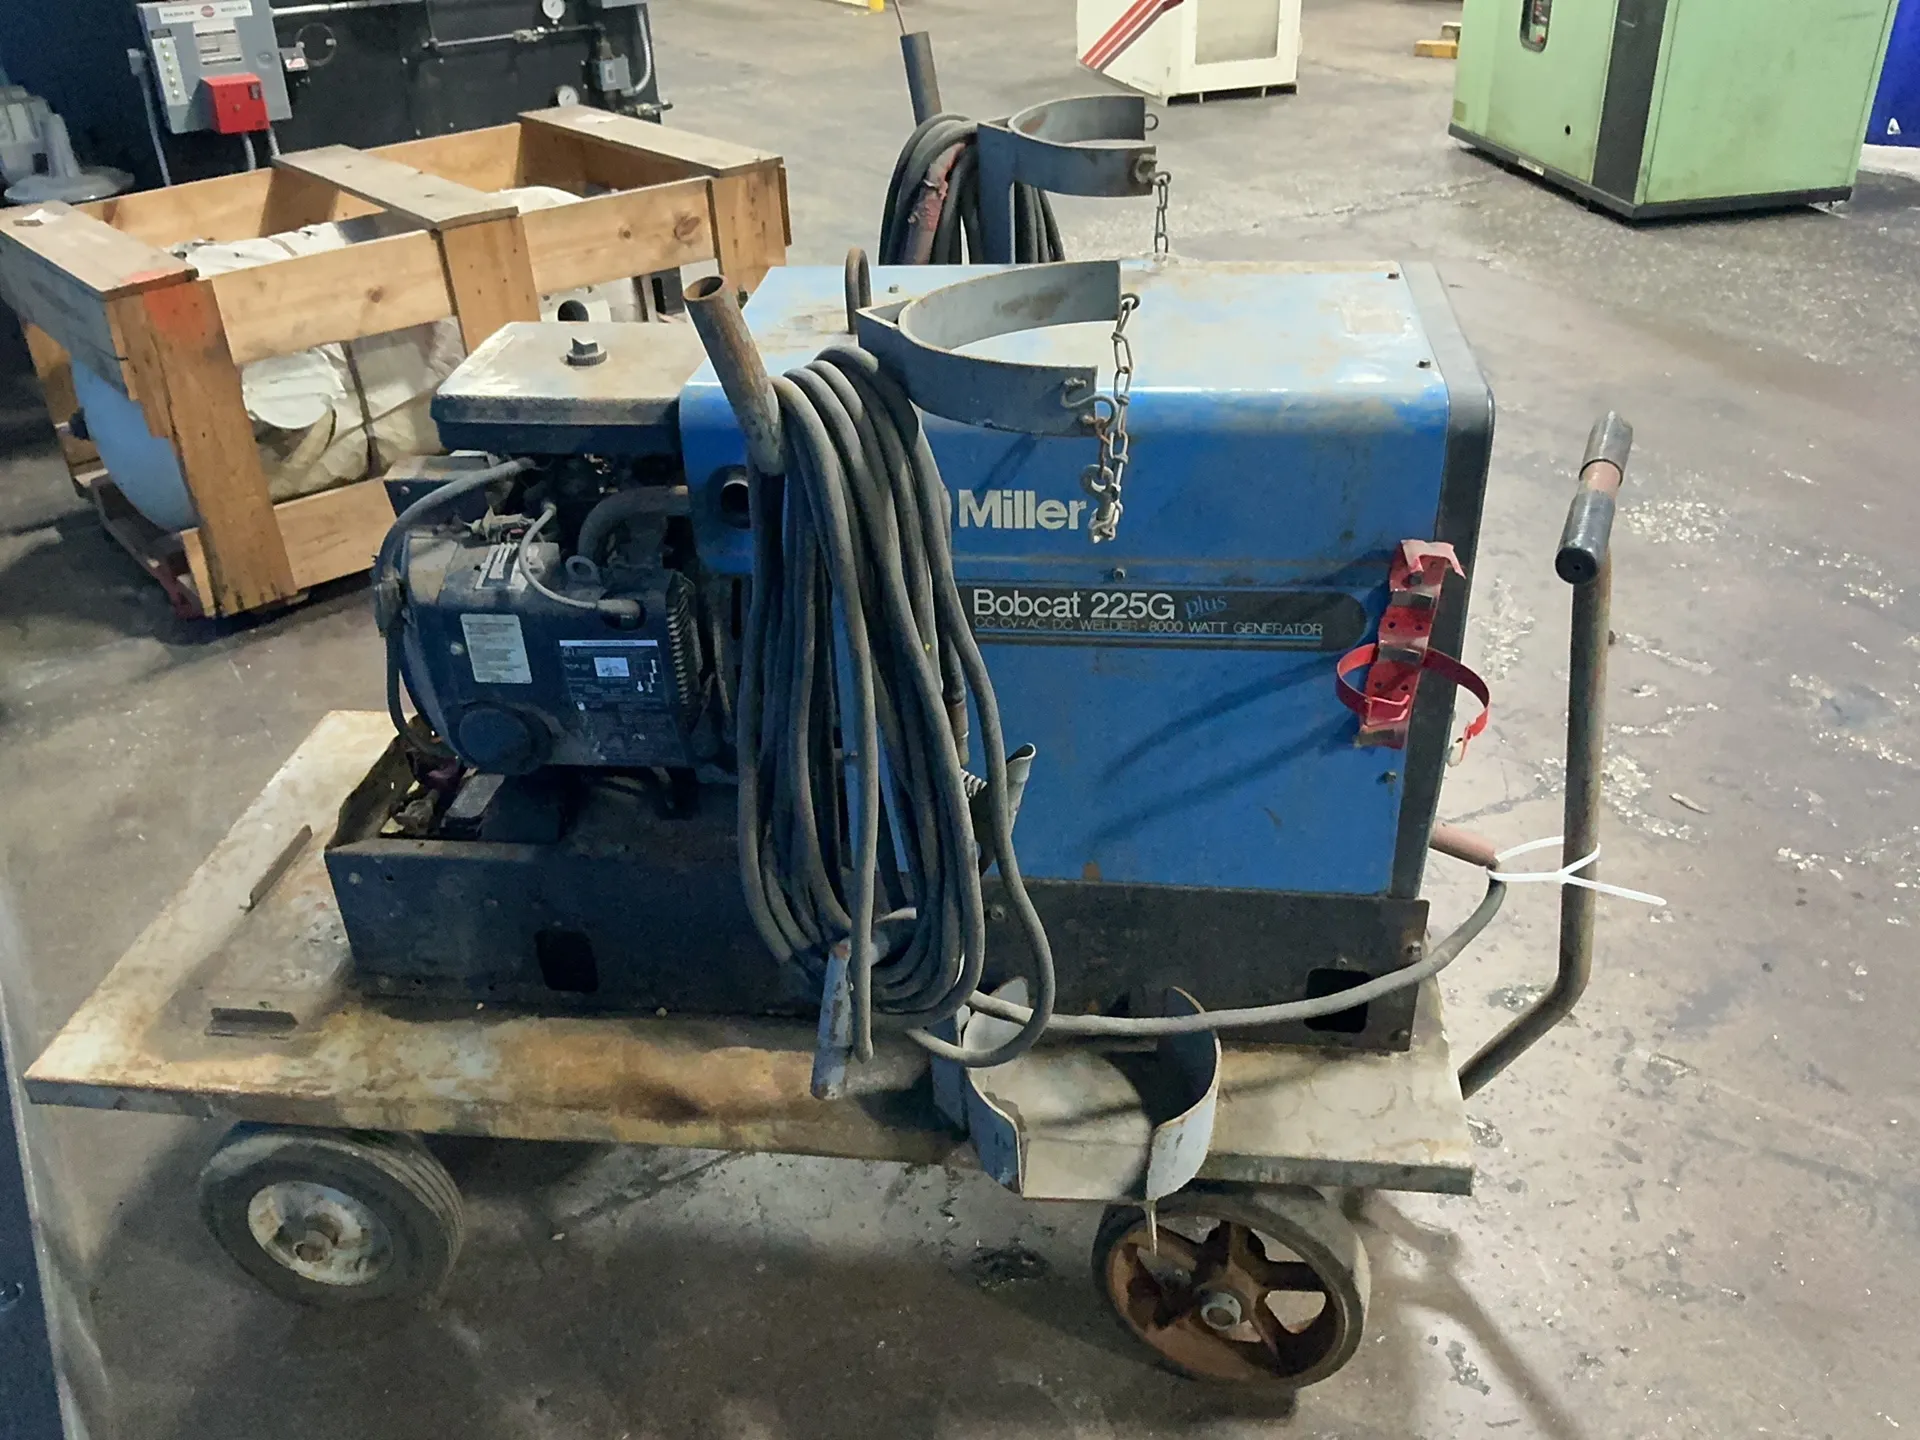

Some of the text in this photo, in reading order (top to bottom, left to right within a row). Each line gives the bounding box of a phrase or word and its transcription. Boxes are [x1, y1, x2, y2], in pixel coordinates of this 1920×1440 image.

[958, 489, 1087, 530] Miller
[973, 589, 1228, 620] Bobcat 225G plus
[1079, 620, 1138, 632] WELDER
[1149, 620, 1184, 633] 8000
[1188, 621, 1228, 634] WATT
[1233, 622, 1323, 635] GENERATOR
